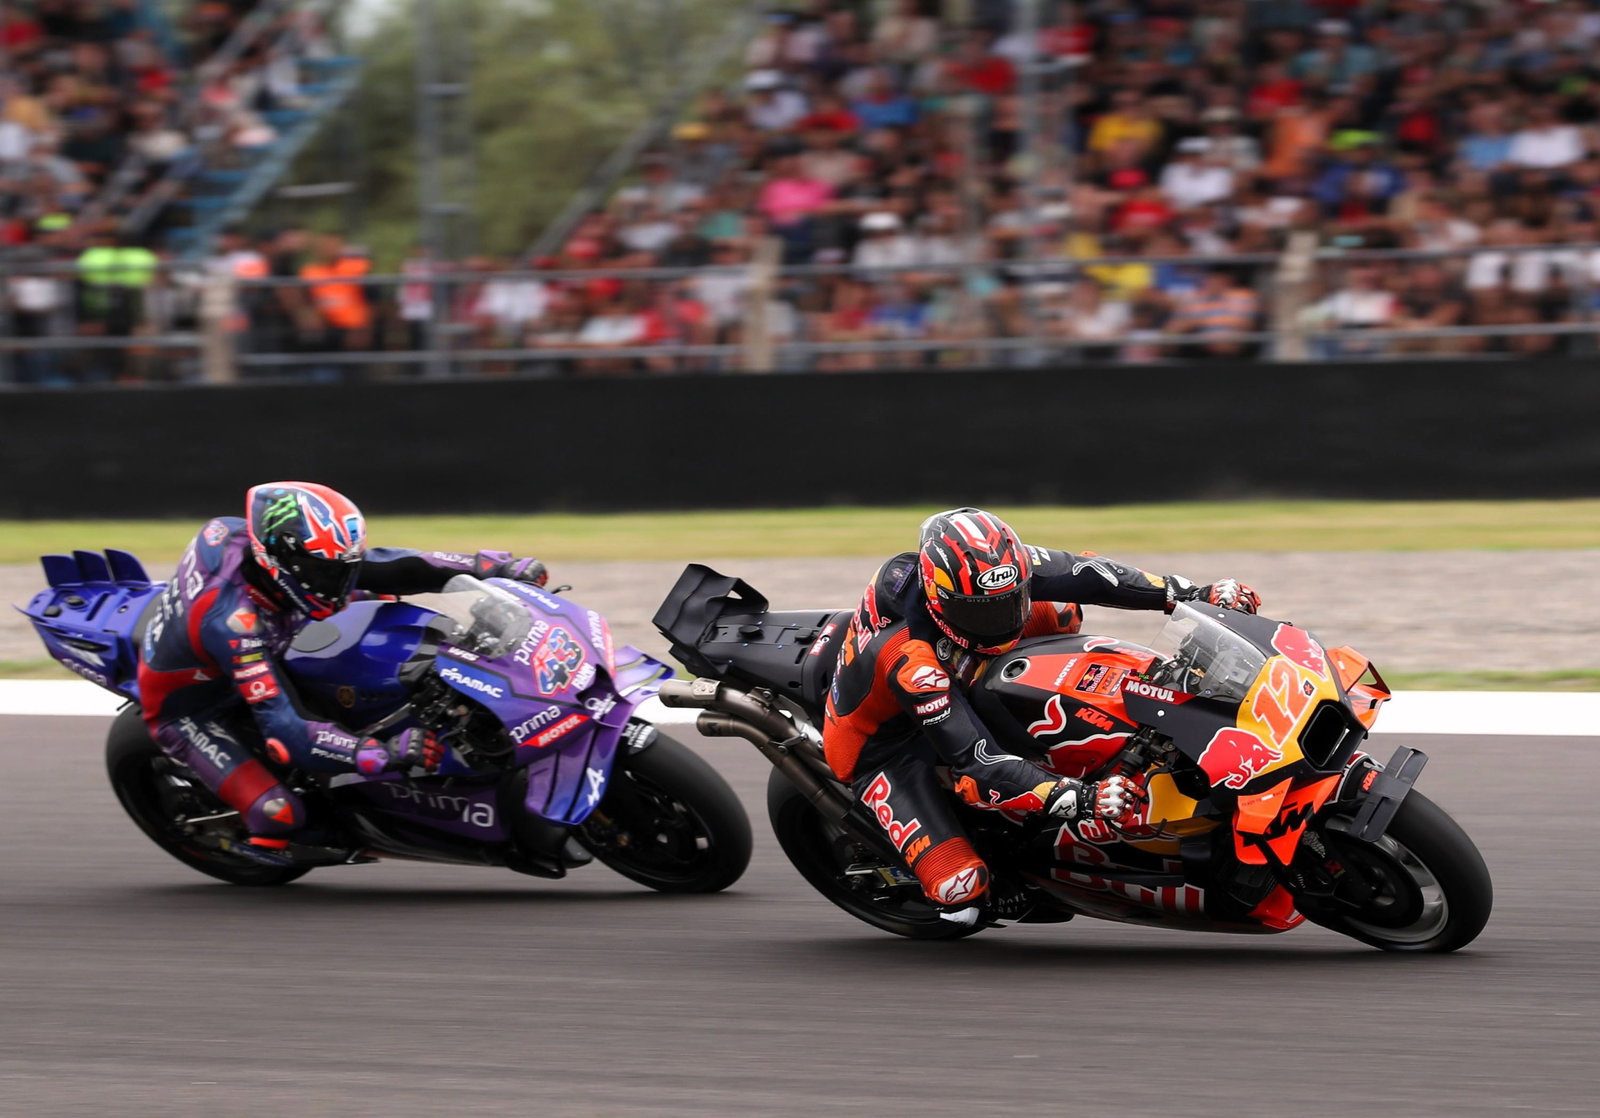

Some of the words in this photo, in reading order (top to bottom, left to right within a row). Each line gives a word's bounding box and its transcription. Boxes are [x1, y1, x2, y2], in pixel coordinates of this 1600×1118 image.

[981, 566, 1014, 585] Arai
[513, 620, 549, 666] prima
[1053, 657, 1077, 686] MOTUL
[916, 695, 949, 714] MOTUL
[1125, 680, 1175, 702] MOTUL
[1252, 658, 1312, 749] 12
[509, 704, 561, 744] prima
[538, 715, 581, 746] MOTUL
[1075, 707, 1114, 731] KTM
[861, 771, 922, 853] Red
[905, 835, 932, 867] KTM
